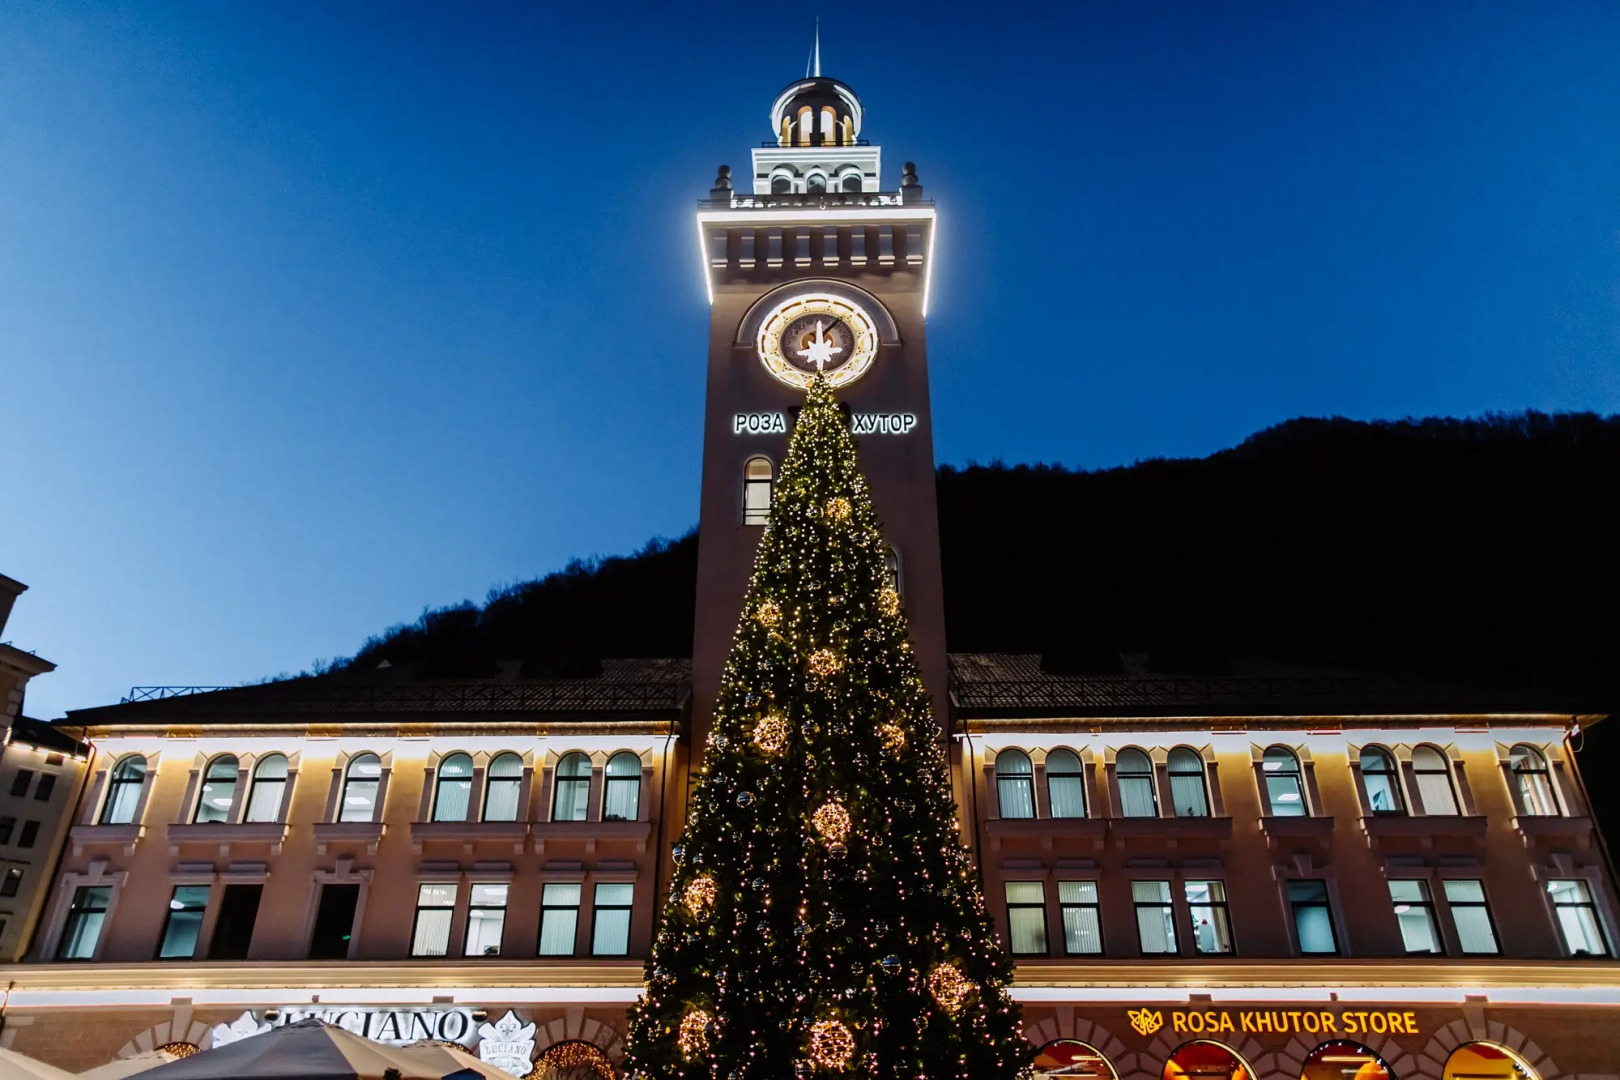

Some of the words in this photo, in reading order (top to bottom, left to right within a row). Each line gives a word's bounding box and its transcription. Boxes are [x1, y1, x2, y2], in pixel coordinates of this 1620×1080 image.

[735, 414, 785, 432] РОЗА
[853, 414, 915, 432] ХУТОР
[1172, 1011, 1236, 1033] ROSA
[1240, 1011, 1338, 1033] KHUTOR
[1341, 1011, 1419, 1034] STORE
[485, 1042, 527, 1055] LUCIANO
